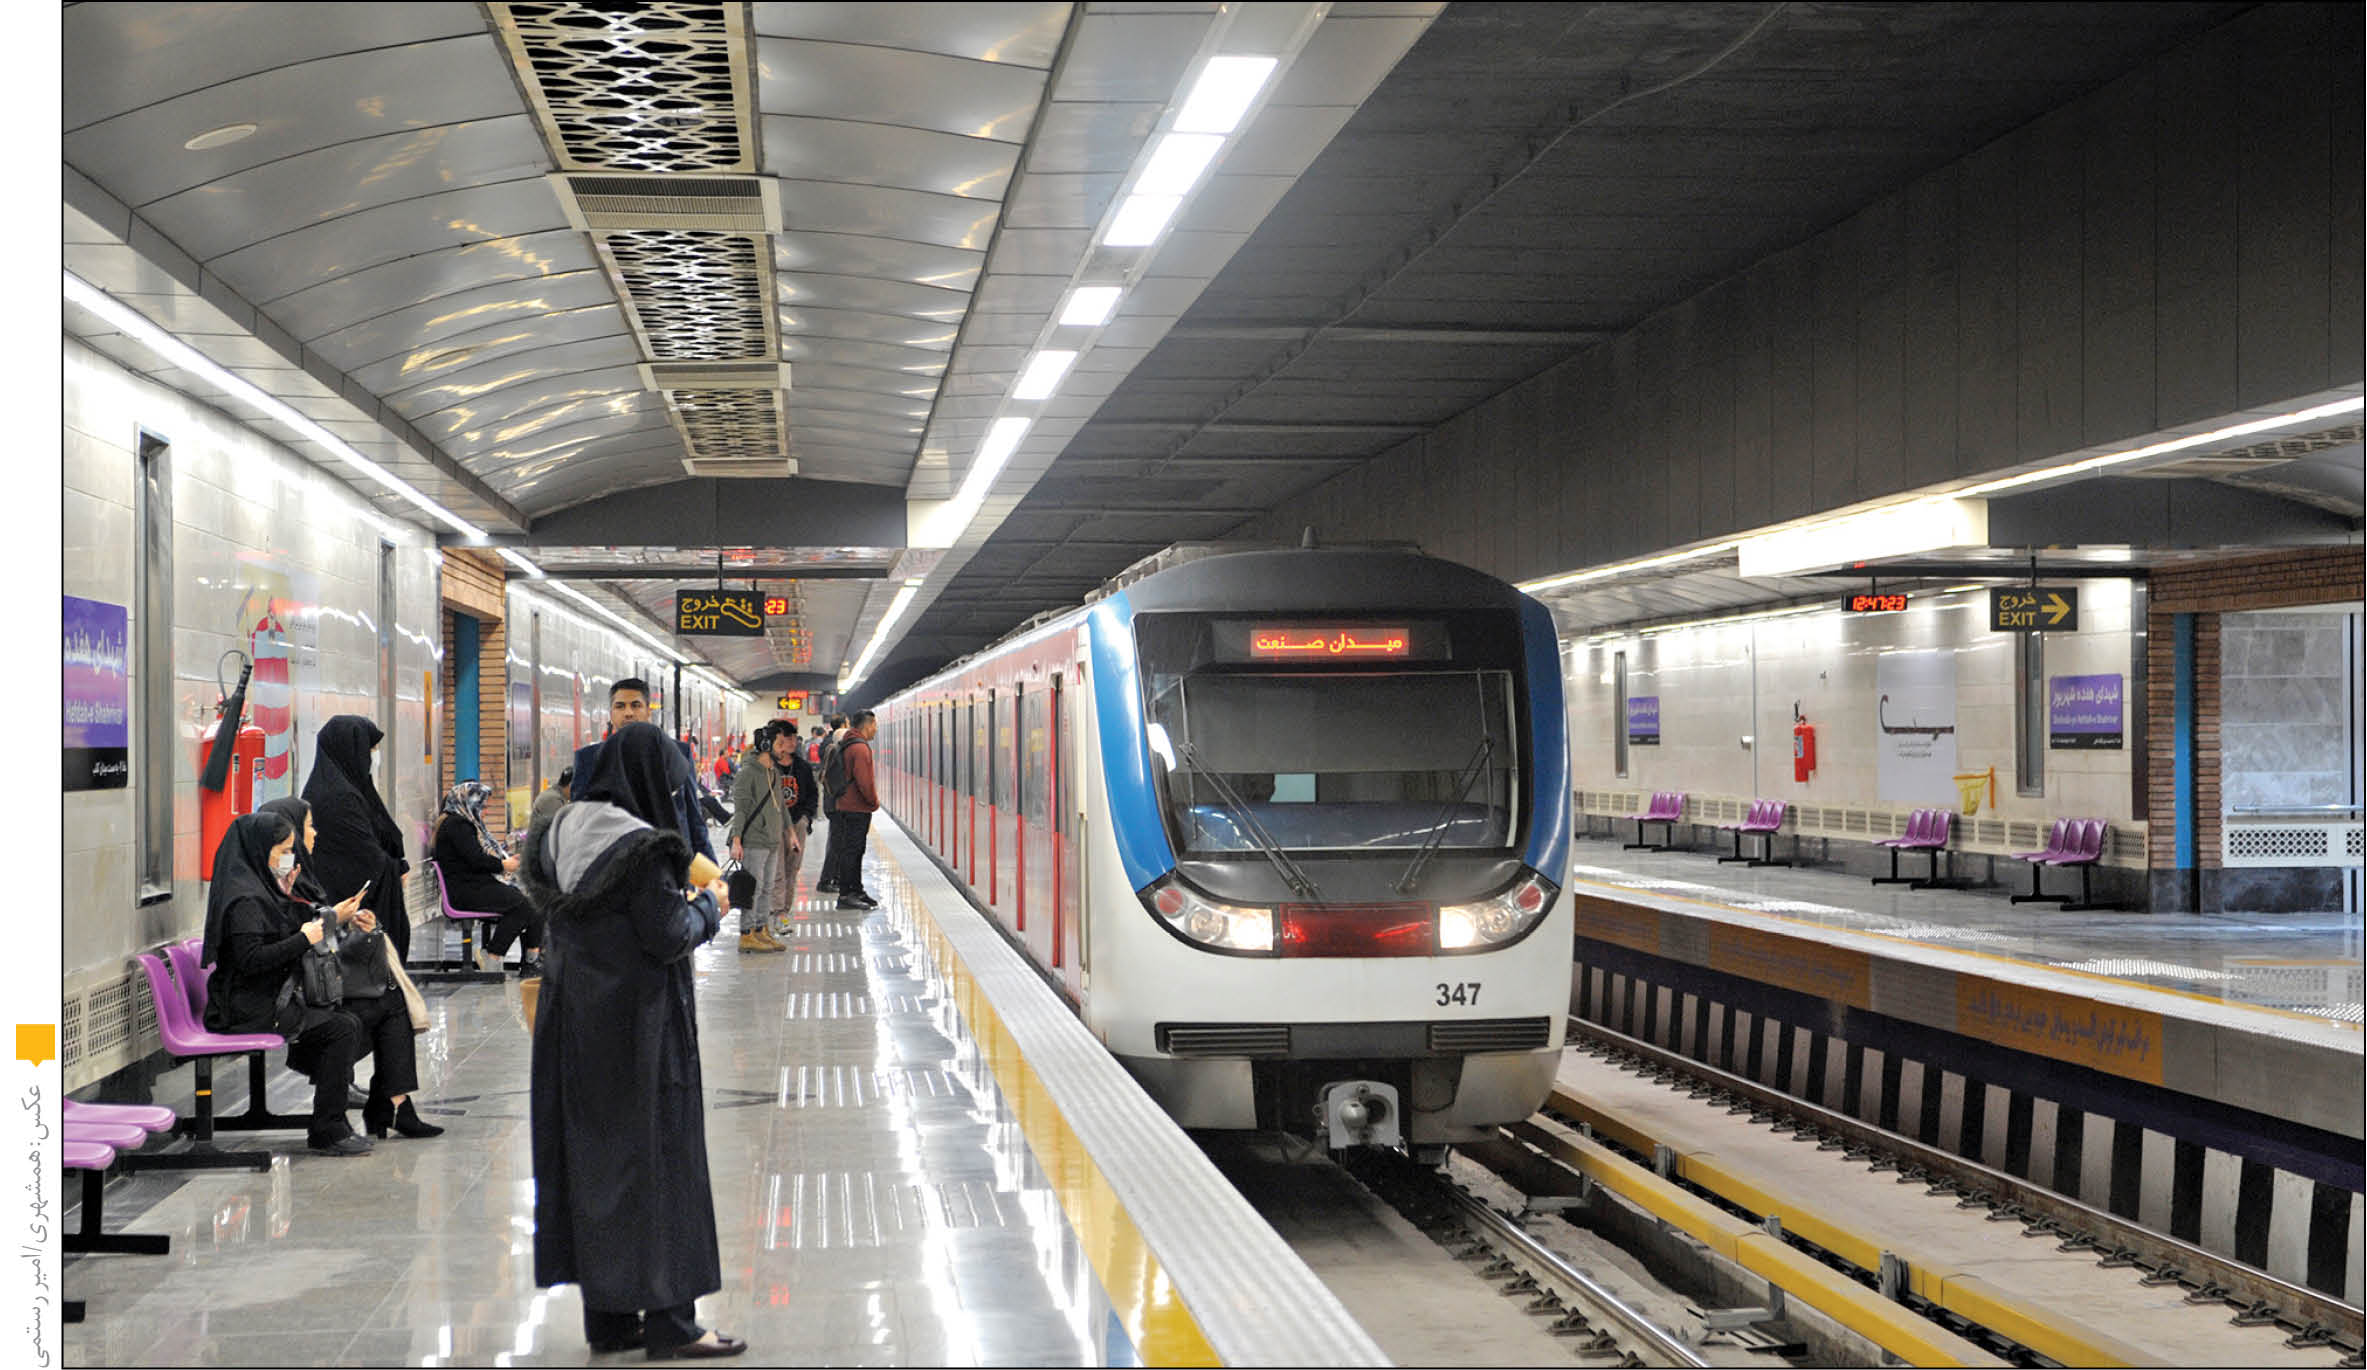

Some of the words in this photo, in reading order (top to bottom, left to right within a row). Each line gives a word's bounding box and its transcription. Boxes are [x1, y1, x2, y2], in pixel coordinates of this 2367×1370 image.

[681, 595, 720, 613] خروج
[1852, 594, 1907, 612] 12:47:23
[2000, 592, 2036, 609] خروج
[681, 615, 720, 630] EXIT
[2000, 611, 2036, 626] EXIT
[1256, 635, 1325, 649] صنعت
[1329, 632, 1403, 652] میدان
[1436, 982, 1481, 1006] 347
